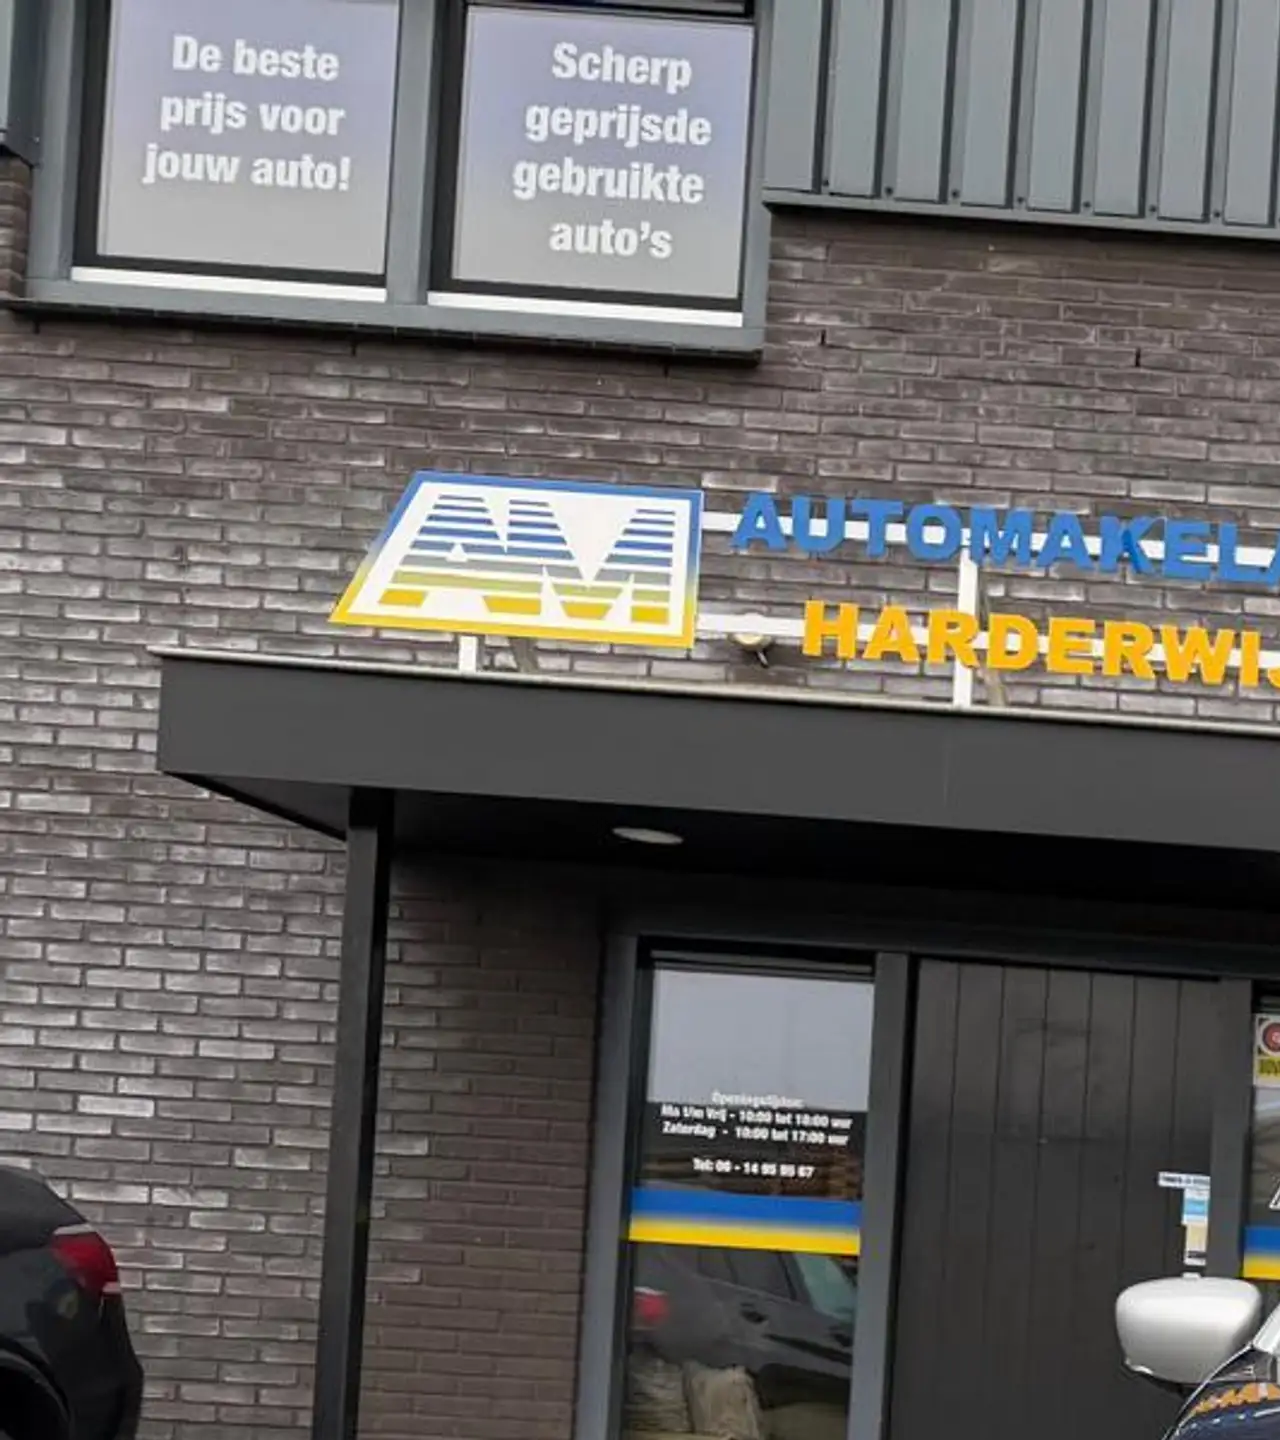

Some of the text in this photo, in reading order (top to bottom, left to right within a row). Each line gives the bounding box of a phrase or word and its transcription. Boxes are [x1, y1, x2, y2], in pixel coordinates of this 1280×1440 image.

[172, 35, 340, 81] De beste
[551, 42, 693, 93] Scherp
[160, 93, 346, 137] prijs voor
[525, 103, 713, 149] geprijsde
[142, 144, 351, 191] jouw auto!
[512, 156, 704, 204] gebruikte
[549, 222, 674, 260] auto's
